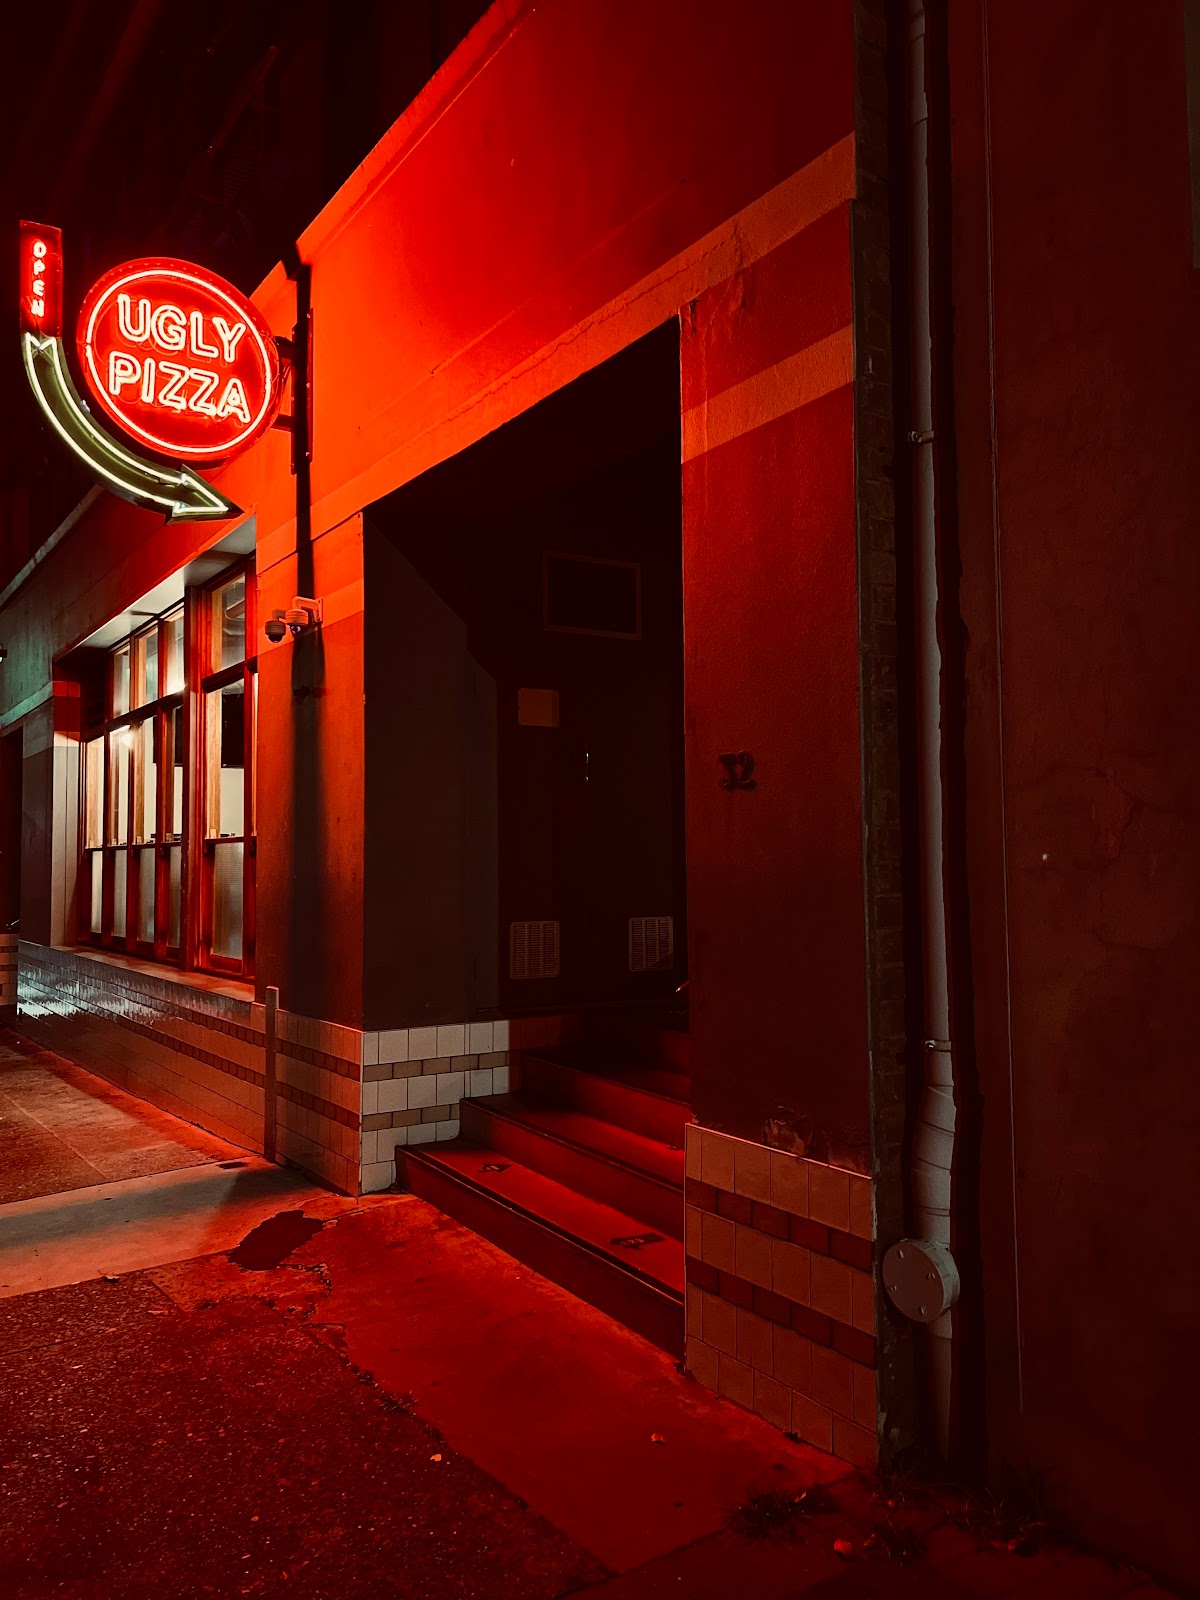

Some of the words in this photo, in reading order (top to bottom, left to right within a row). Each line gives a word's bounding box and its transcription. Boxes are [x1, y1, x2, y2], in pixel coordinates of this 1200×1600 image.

[31, 241, 47, 318] OPEN
[117, 293, 246, 363] UGLY
[109, 351, 251, 424] PIZZA
